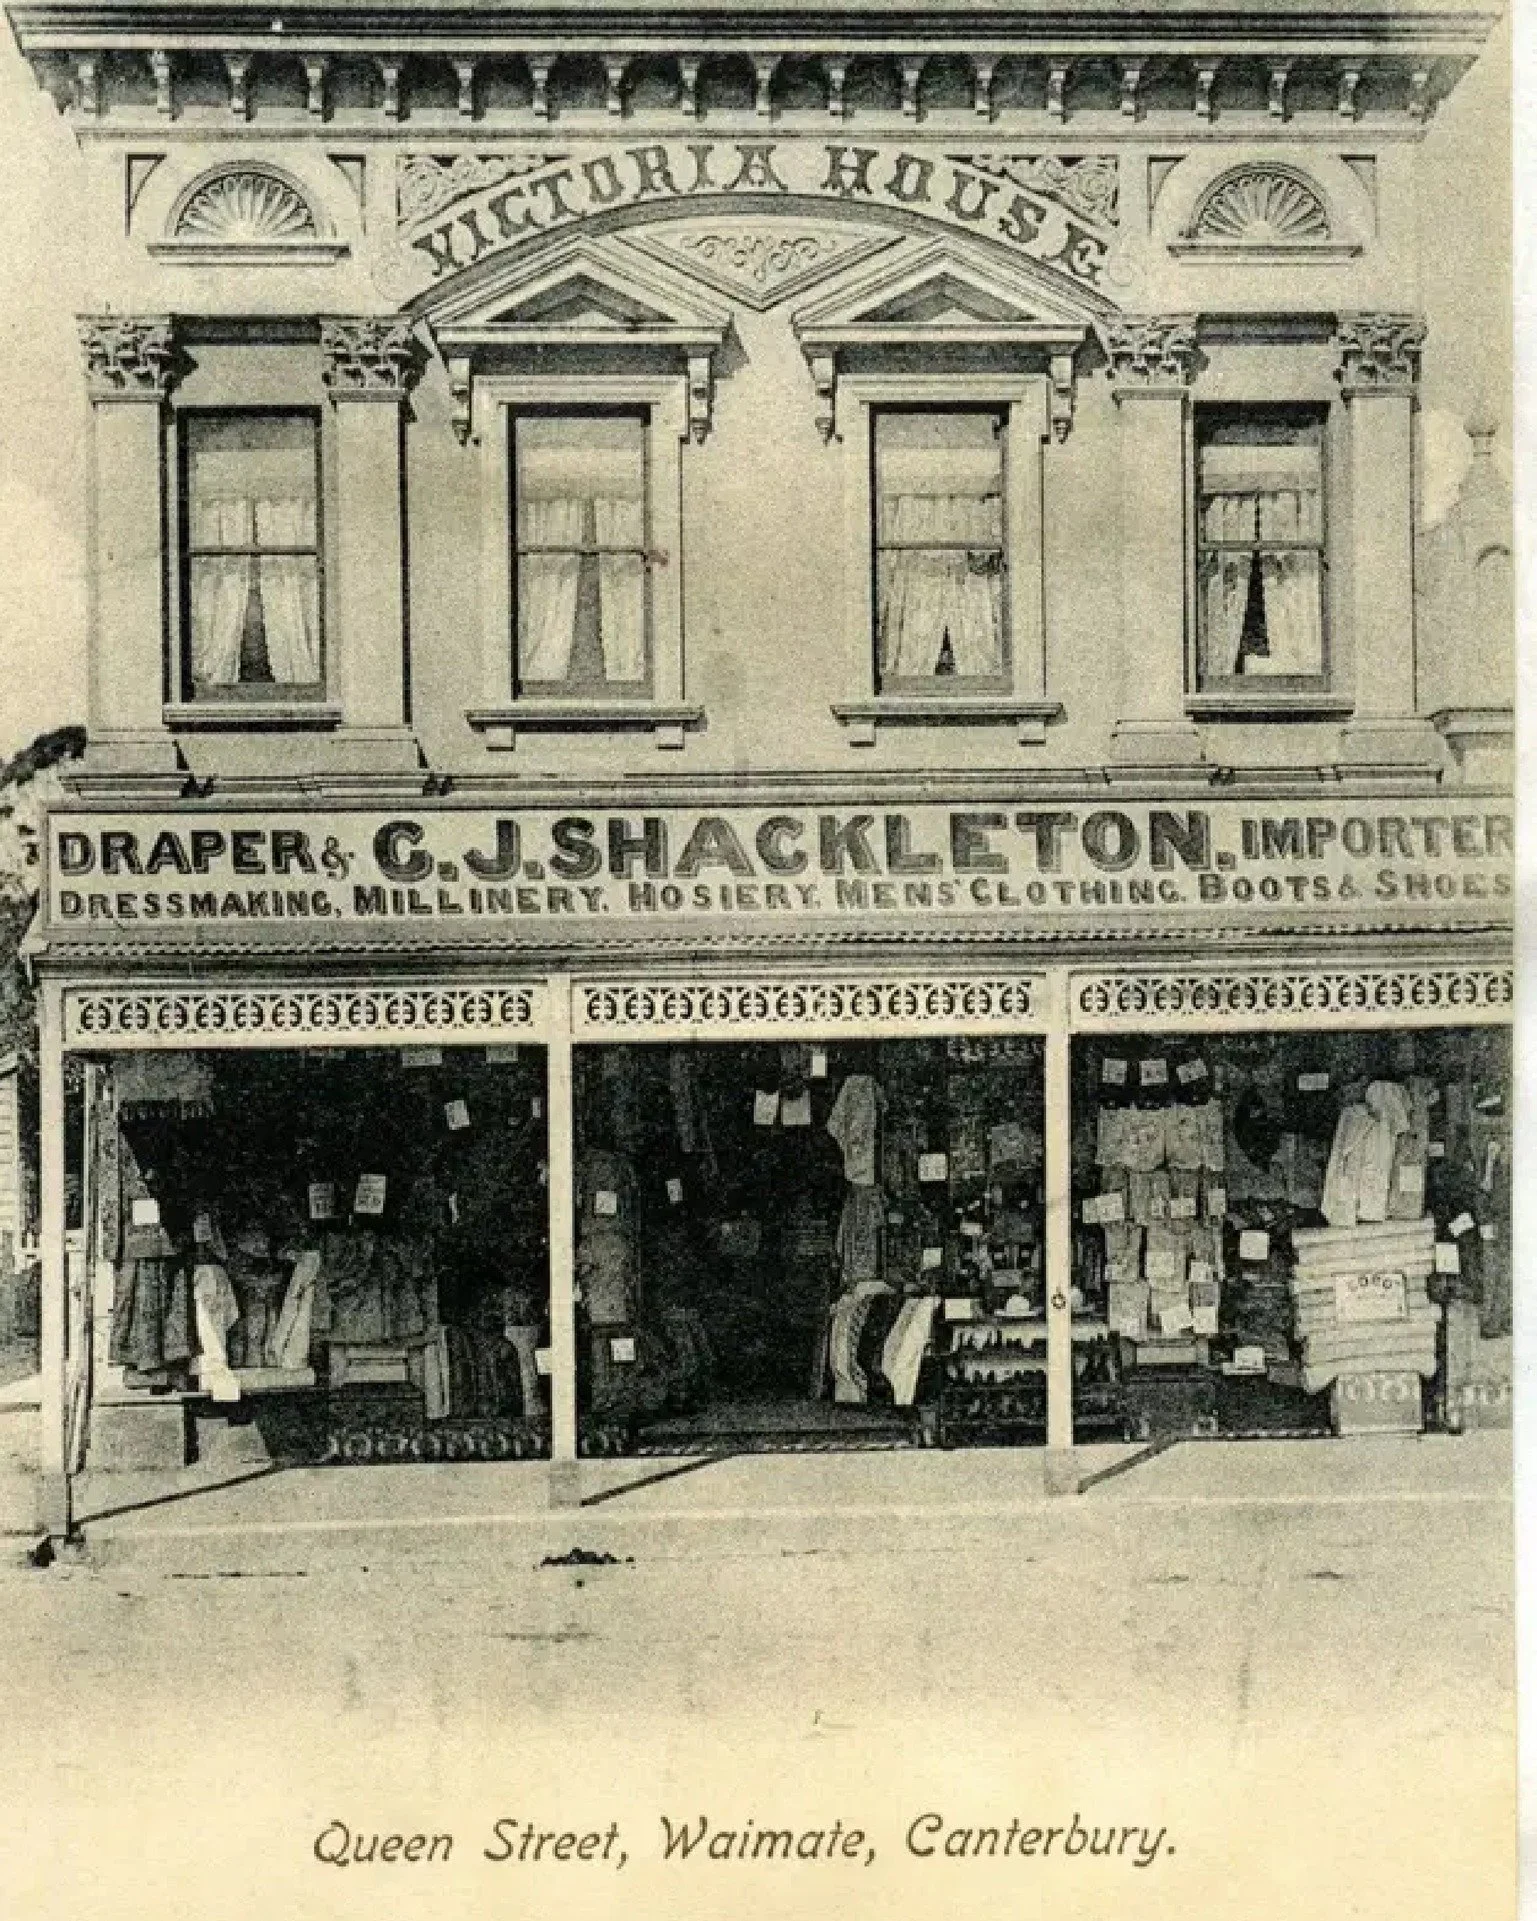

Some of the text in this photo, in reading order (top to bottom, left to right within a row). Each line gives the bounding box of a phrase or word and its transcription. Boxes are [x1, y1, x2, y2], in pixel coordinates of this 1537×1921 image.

[411, 144, 1108, 285] VICTORIA HOUSE
[58, 829, 317, 876] DRAPER
[1241, 814, 1514, 861] IMPORTER
[1374, 868, 1512, 902] SHOES
